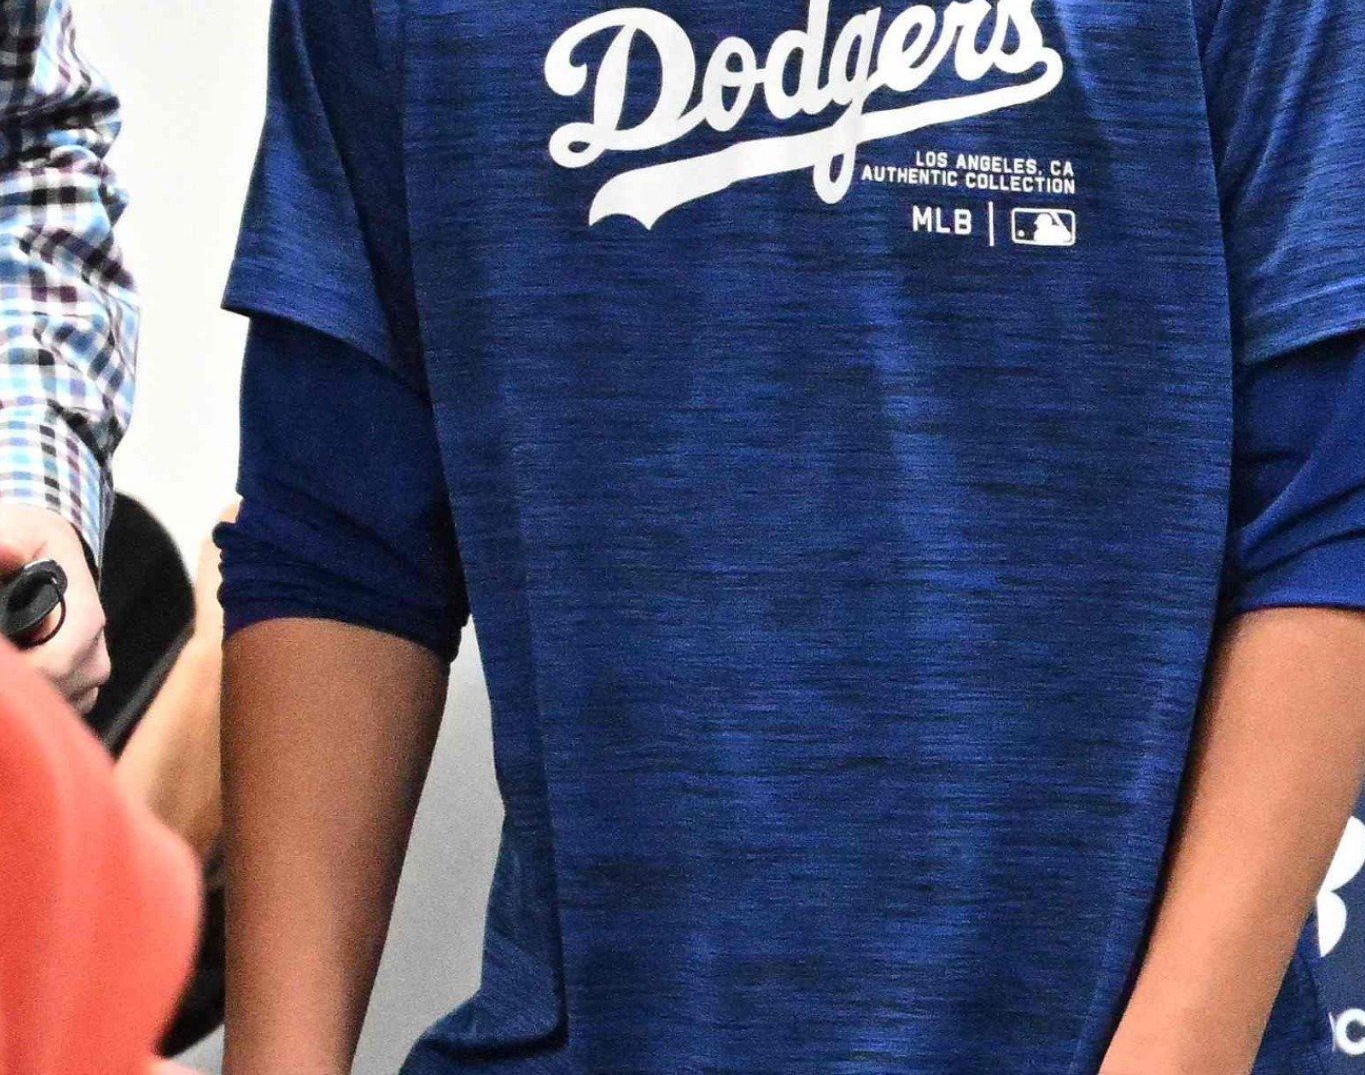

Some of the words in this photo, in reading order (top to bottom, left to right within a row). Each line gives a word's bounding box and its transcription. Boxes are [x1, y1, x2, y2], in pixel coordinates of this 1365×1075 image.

[916, 151, 948, 167] LOS
[955, 155, 1042, 176] ANGELES,
[1050, 160, 1075, 176] CA
[861, 165, 958, 186] AUTHENTIC
[965, 174, 1076, 194] COLLECTION
[912, 205, 972, 235] MLB
